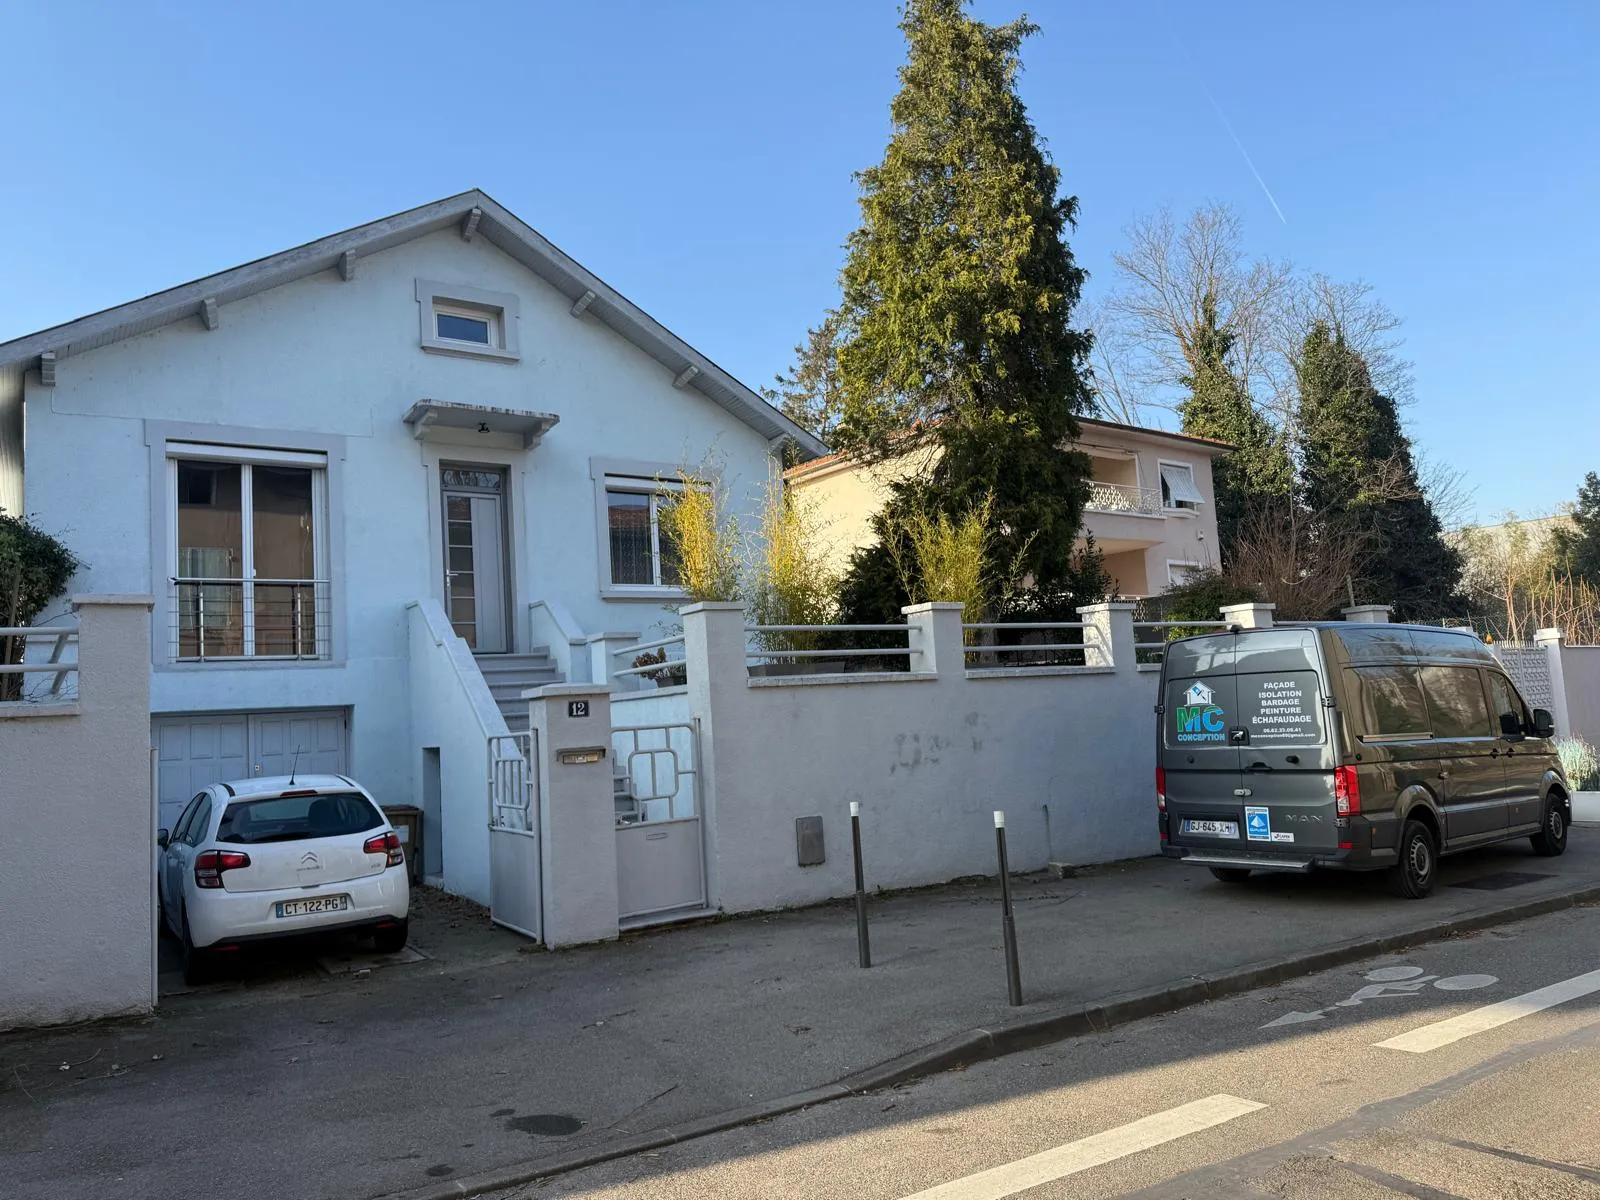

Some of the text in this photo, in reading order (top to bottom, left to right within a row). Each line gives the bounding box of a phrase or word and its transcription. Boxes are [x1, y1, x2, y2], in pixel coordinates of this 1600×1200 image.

[1263, 681, 1295, 690] FAÇADE
[1258, 690, 1302, 698] ISOLATION
[572, 702, 585, 716] 12
[1260, 707, 1302, 715] PEINTURE
[1176, 705, 1225, 732] MC
[1252, 715, 1312, 724] ÉCHAFAUDAGE
[1177, 733, 1226, 741] CONCEPTION
[1285, 814, 1324, 824] MAN
[285, 898, 339, 915] CT-122-PG
